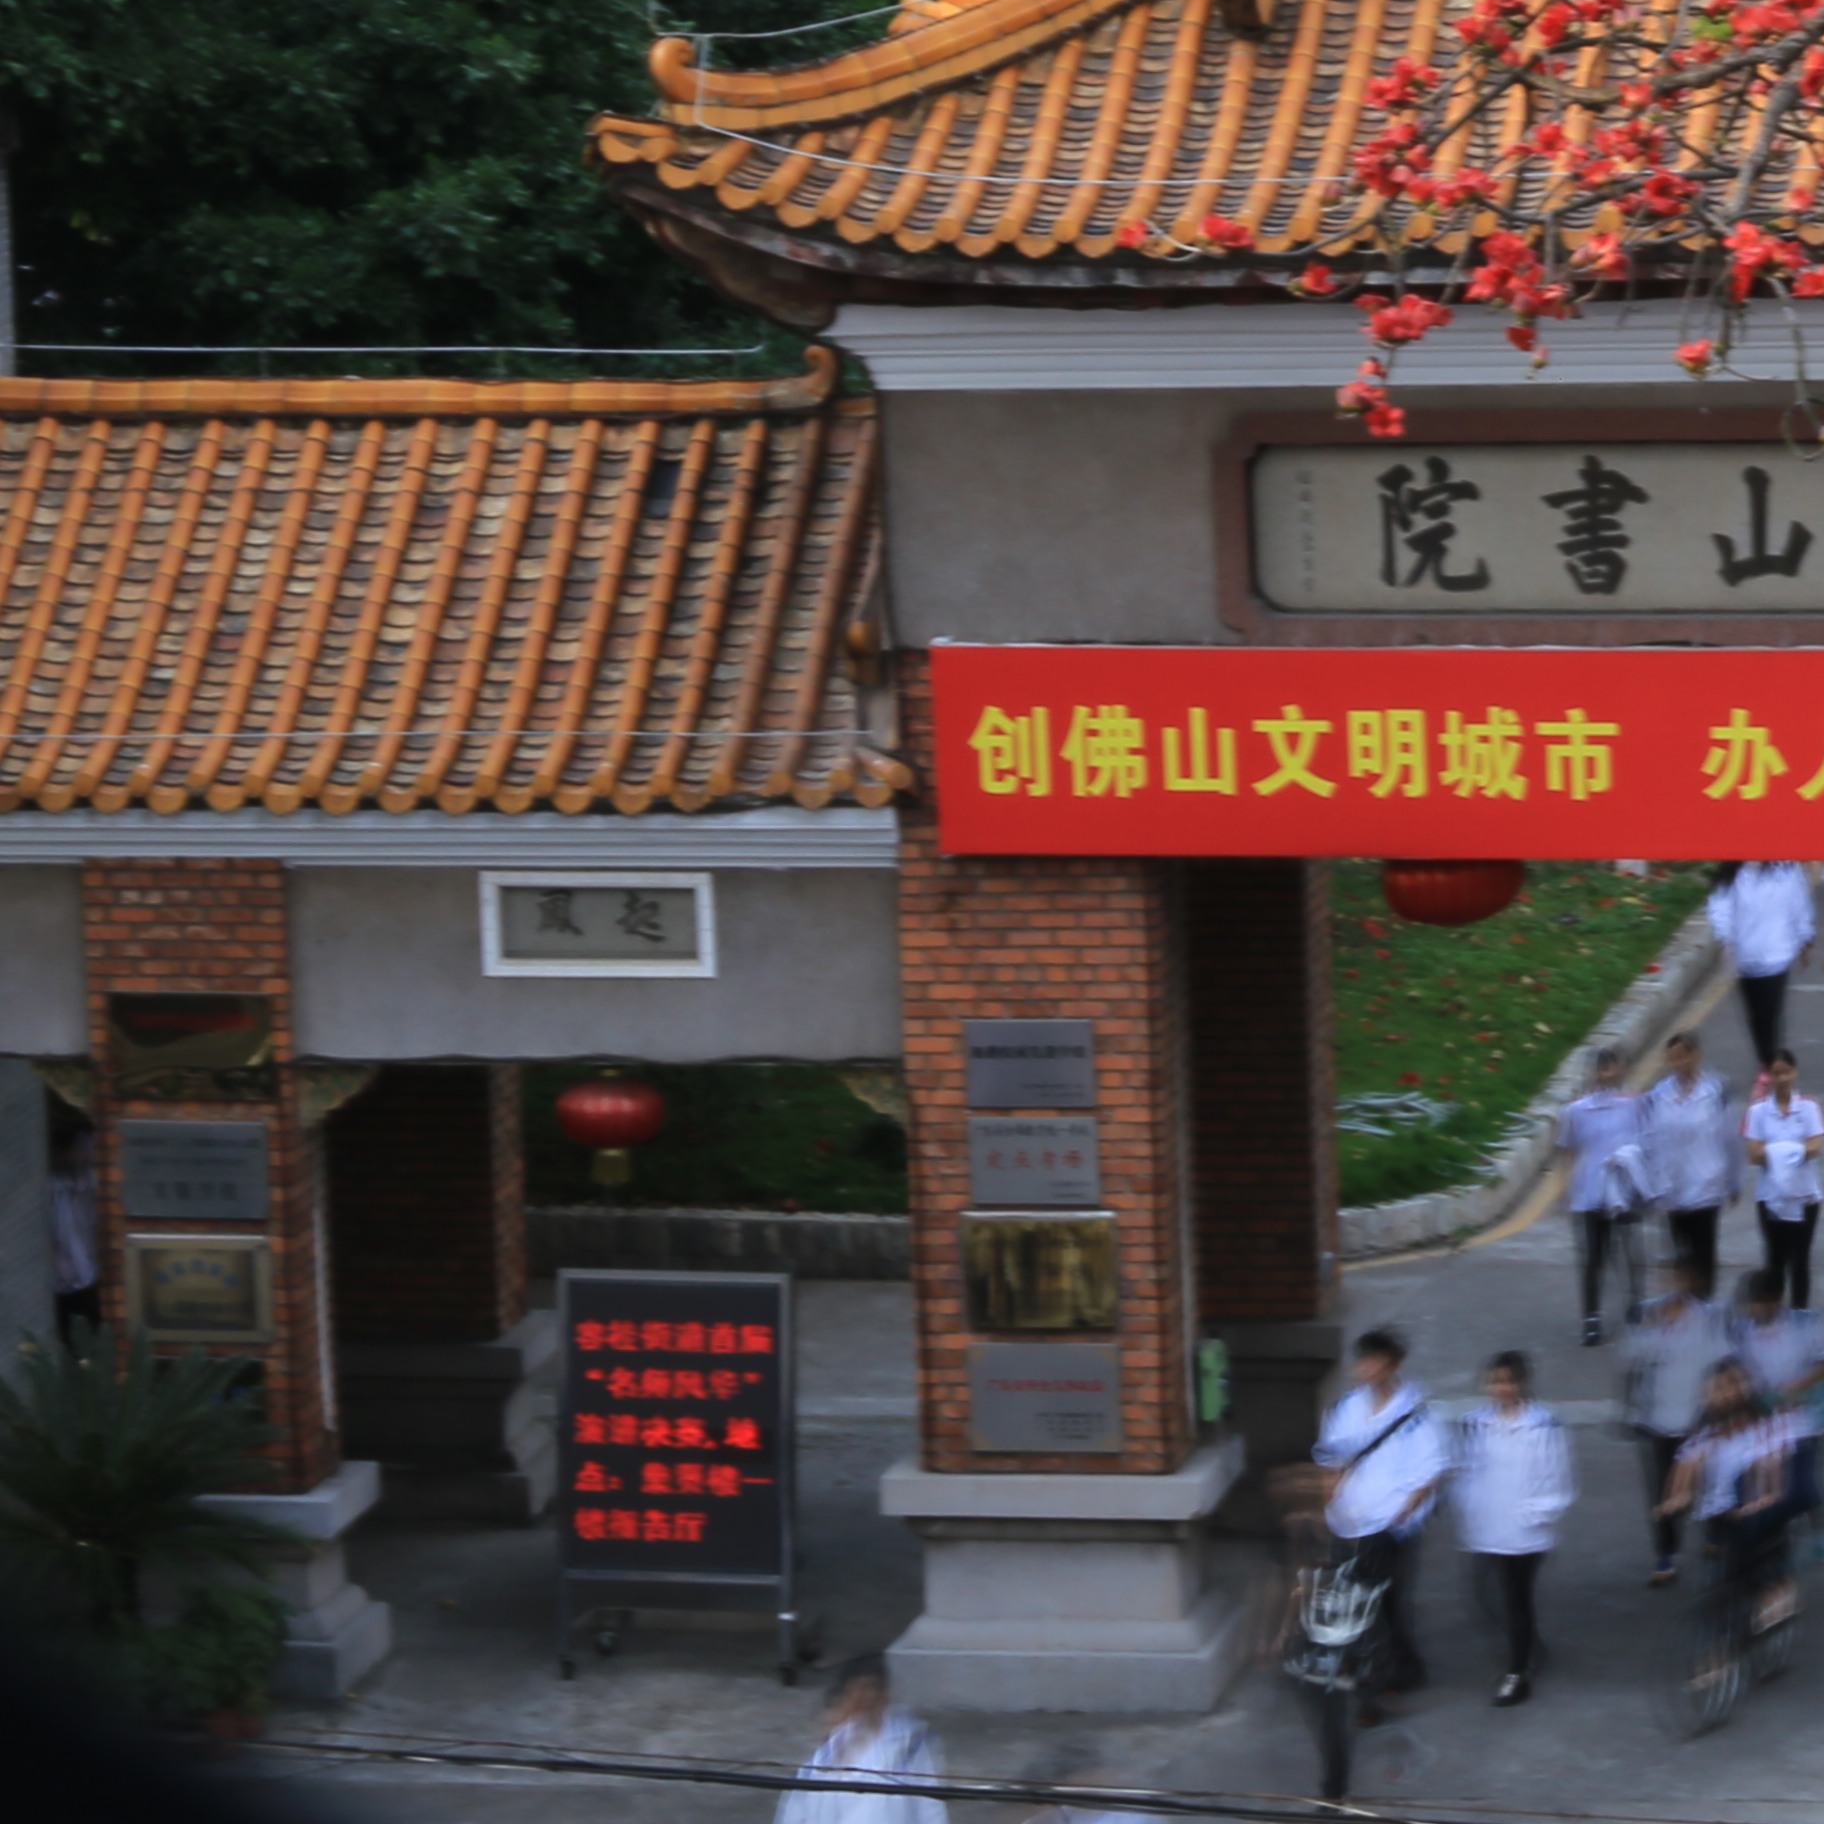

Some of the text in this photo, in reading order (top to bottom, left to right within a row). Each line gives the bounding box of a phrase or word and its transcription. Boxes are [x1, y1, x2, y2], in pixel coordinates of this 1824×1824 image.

[968, 704, 1621, 801] 创佛山文明城市
